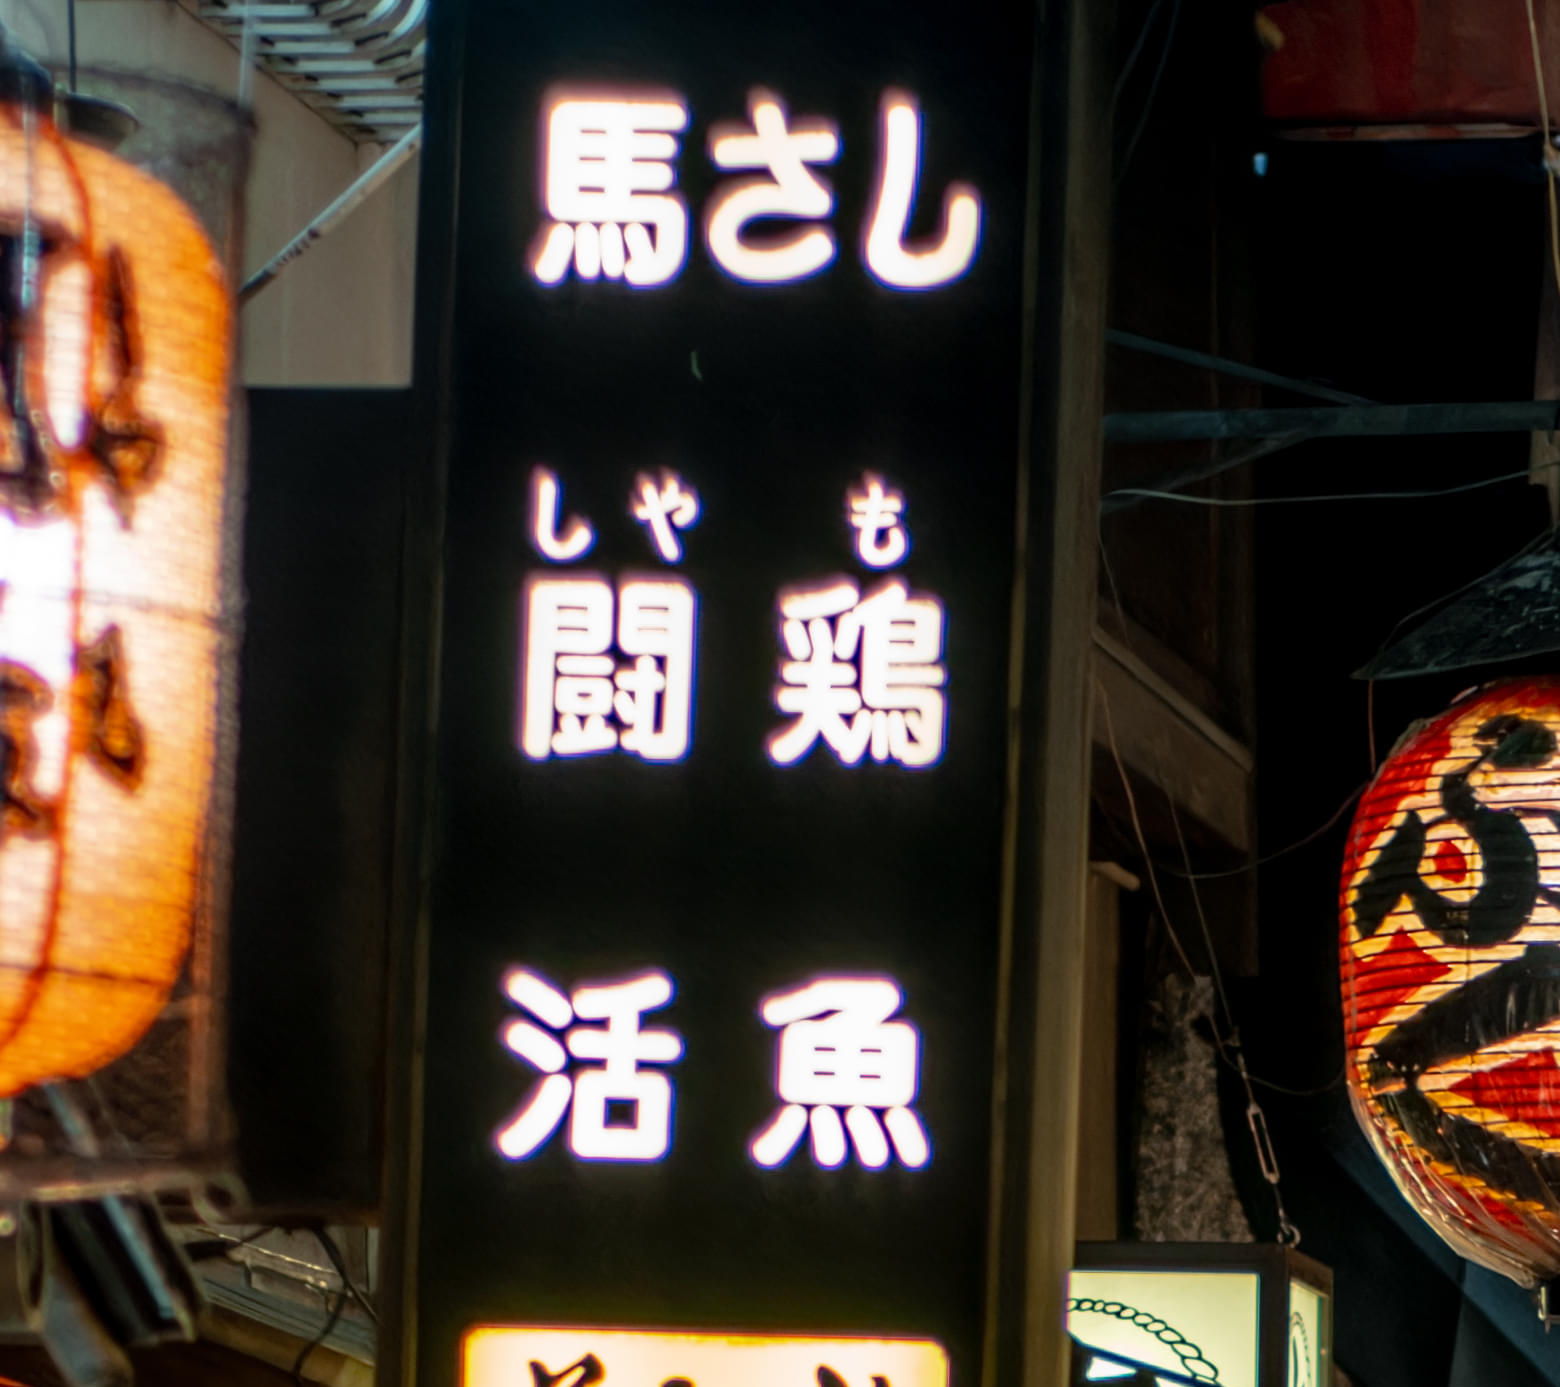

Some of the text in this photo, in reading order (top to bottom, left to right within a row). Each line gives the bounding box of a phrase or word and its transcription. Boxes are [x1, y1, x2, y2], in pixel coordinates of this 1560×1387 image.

[530, 88, 980, 288] 馬さし
[522, 575, 946, 767] 闘鶏
[496, 966, 932, 1169] 活魚
